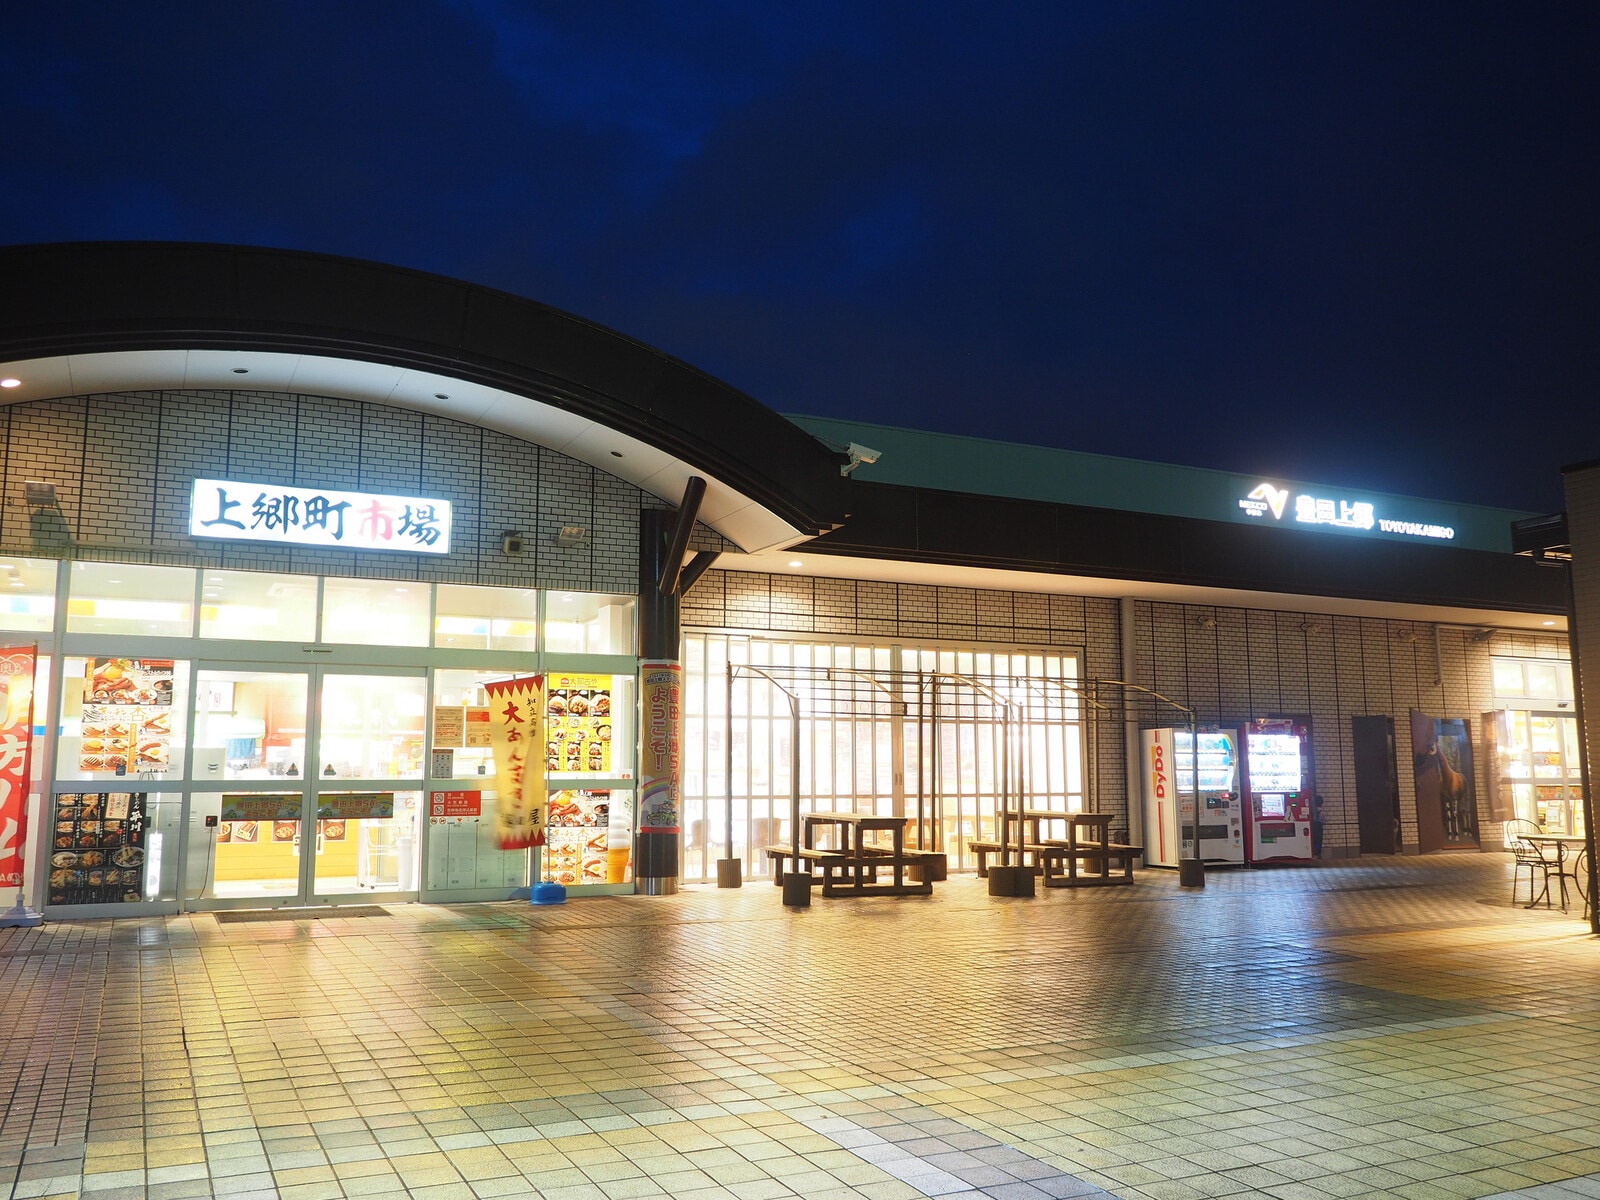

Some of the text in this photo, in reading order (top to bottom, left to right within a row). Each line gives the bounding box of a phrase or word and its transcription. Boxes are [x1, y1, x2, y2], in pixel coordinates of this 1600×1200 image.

[200, 487, 442, 546] 上郷町市場
[650, 686, 667, 772] ようこそ!
[1154, 745, 1167, 799] DyDo
